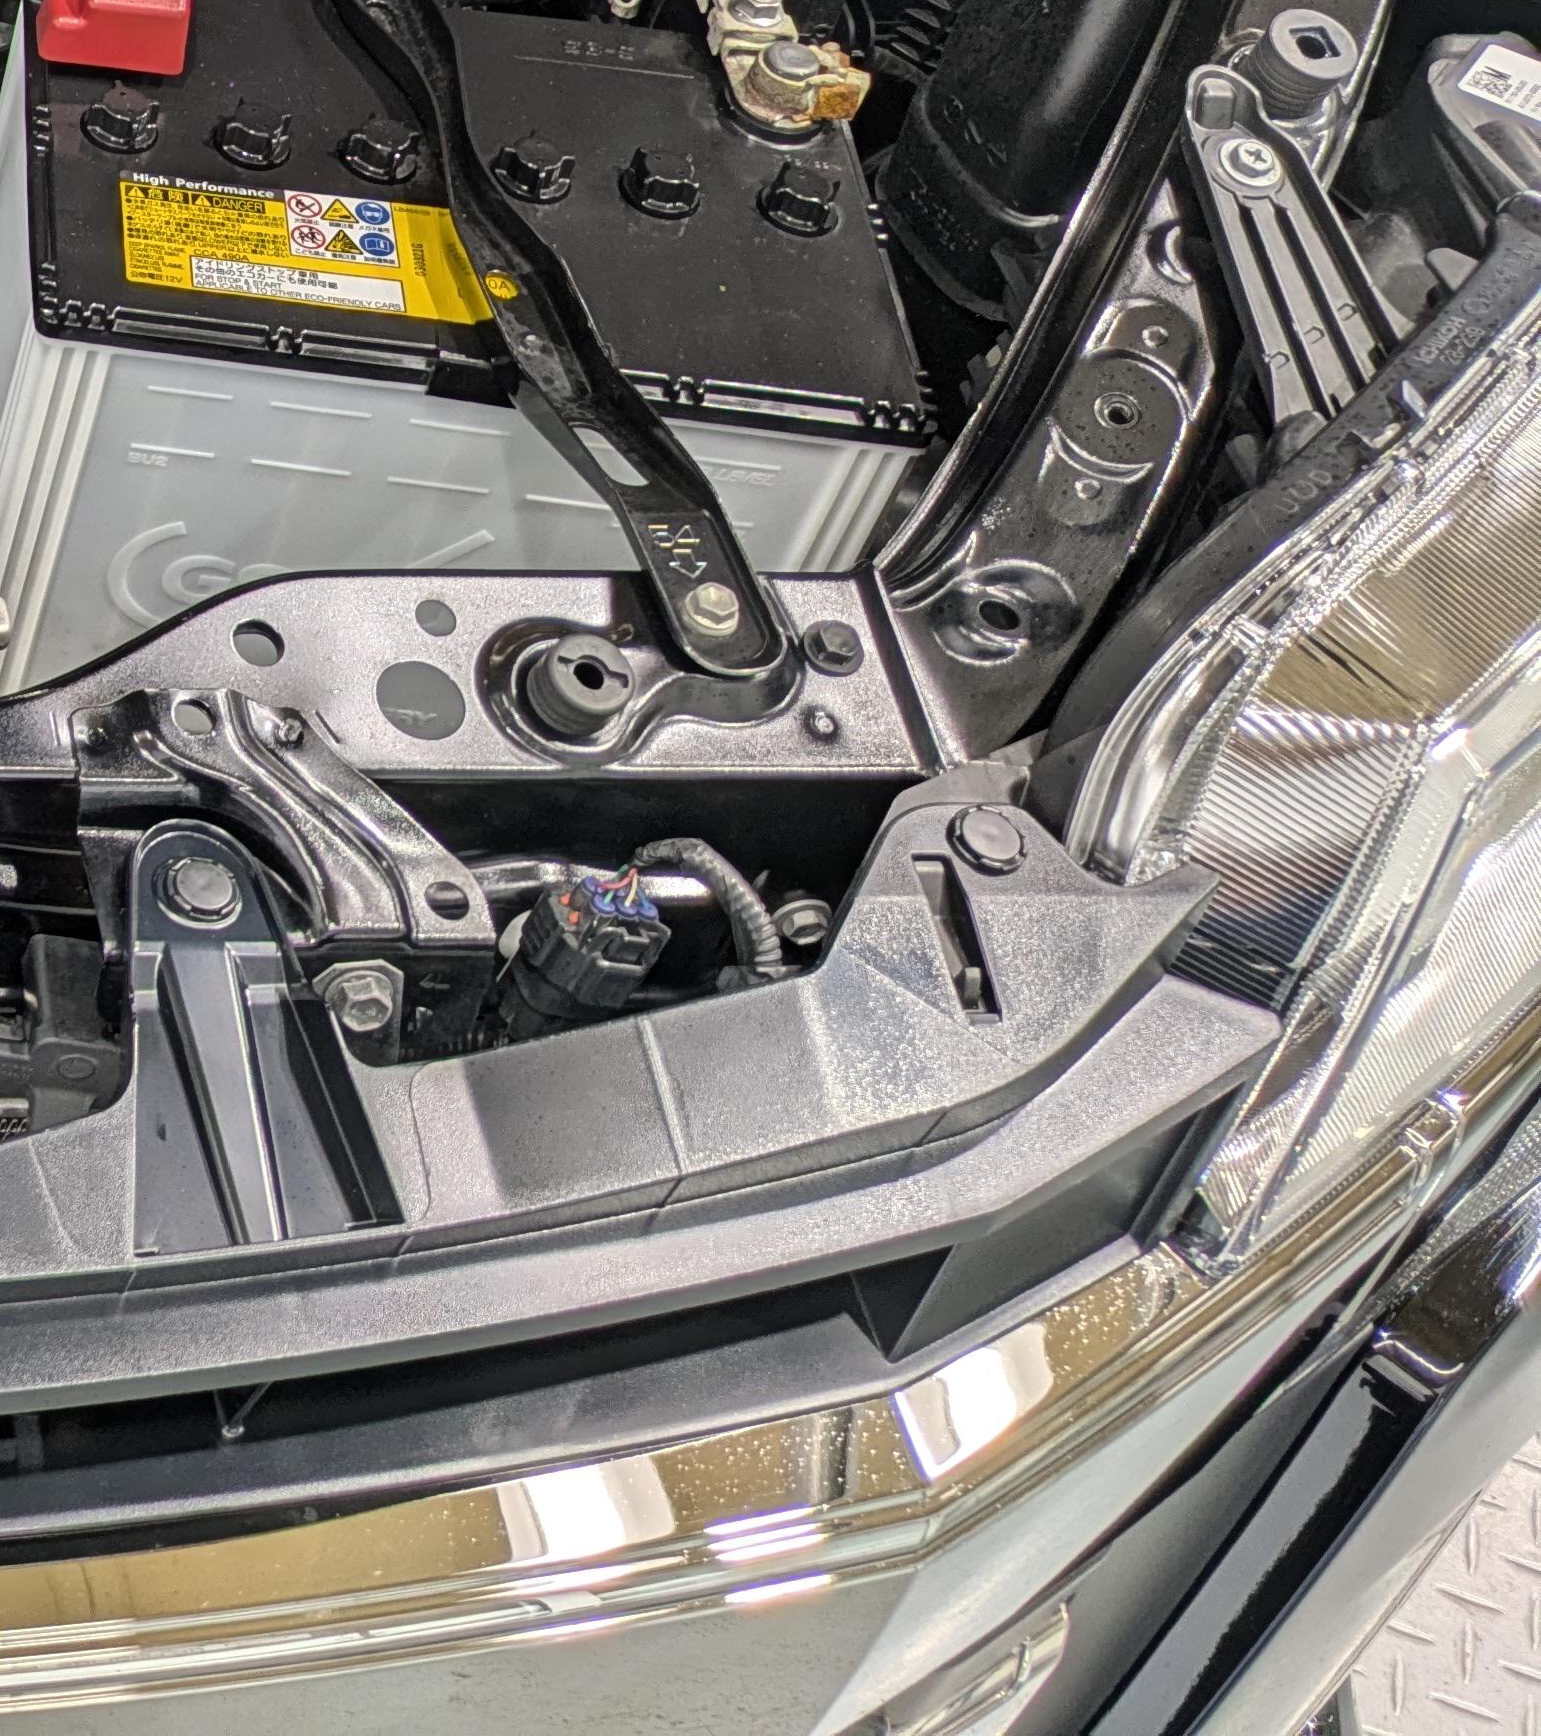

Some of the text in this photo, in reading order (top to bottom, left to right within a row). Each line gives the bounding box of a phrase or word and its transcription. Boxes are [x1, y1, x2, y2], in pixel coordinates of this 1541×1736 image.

[132, 172, 275, 199] High Performance
[212, 197, 263, 213] DANGER
[193, 249, 218, 258] CCA
[195, 265, 338, 290] その他のエコカーにも使用可能
[217, 275, 242, 284] STOP
[252, 280, 282, 290] START
[195, 279, 253, 294] APPLICABLE
[270, 288, 302, 299] OTHER
[304, 292, 373, 307] ECO-FRIENDLY
[374, 300, 402, 311] CARS
